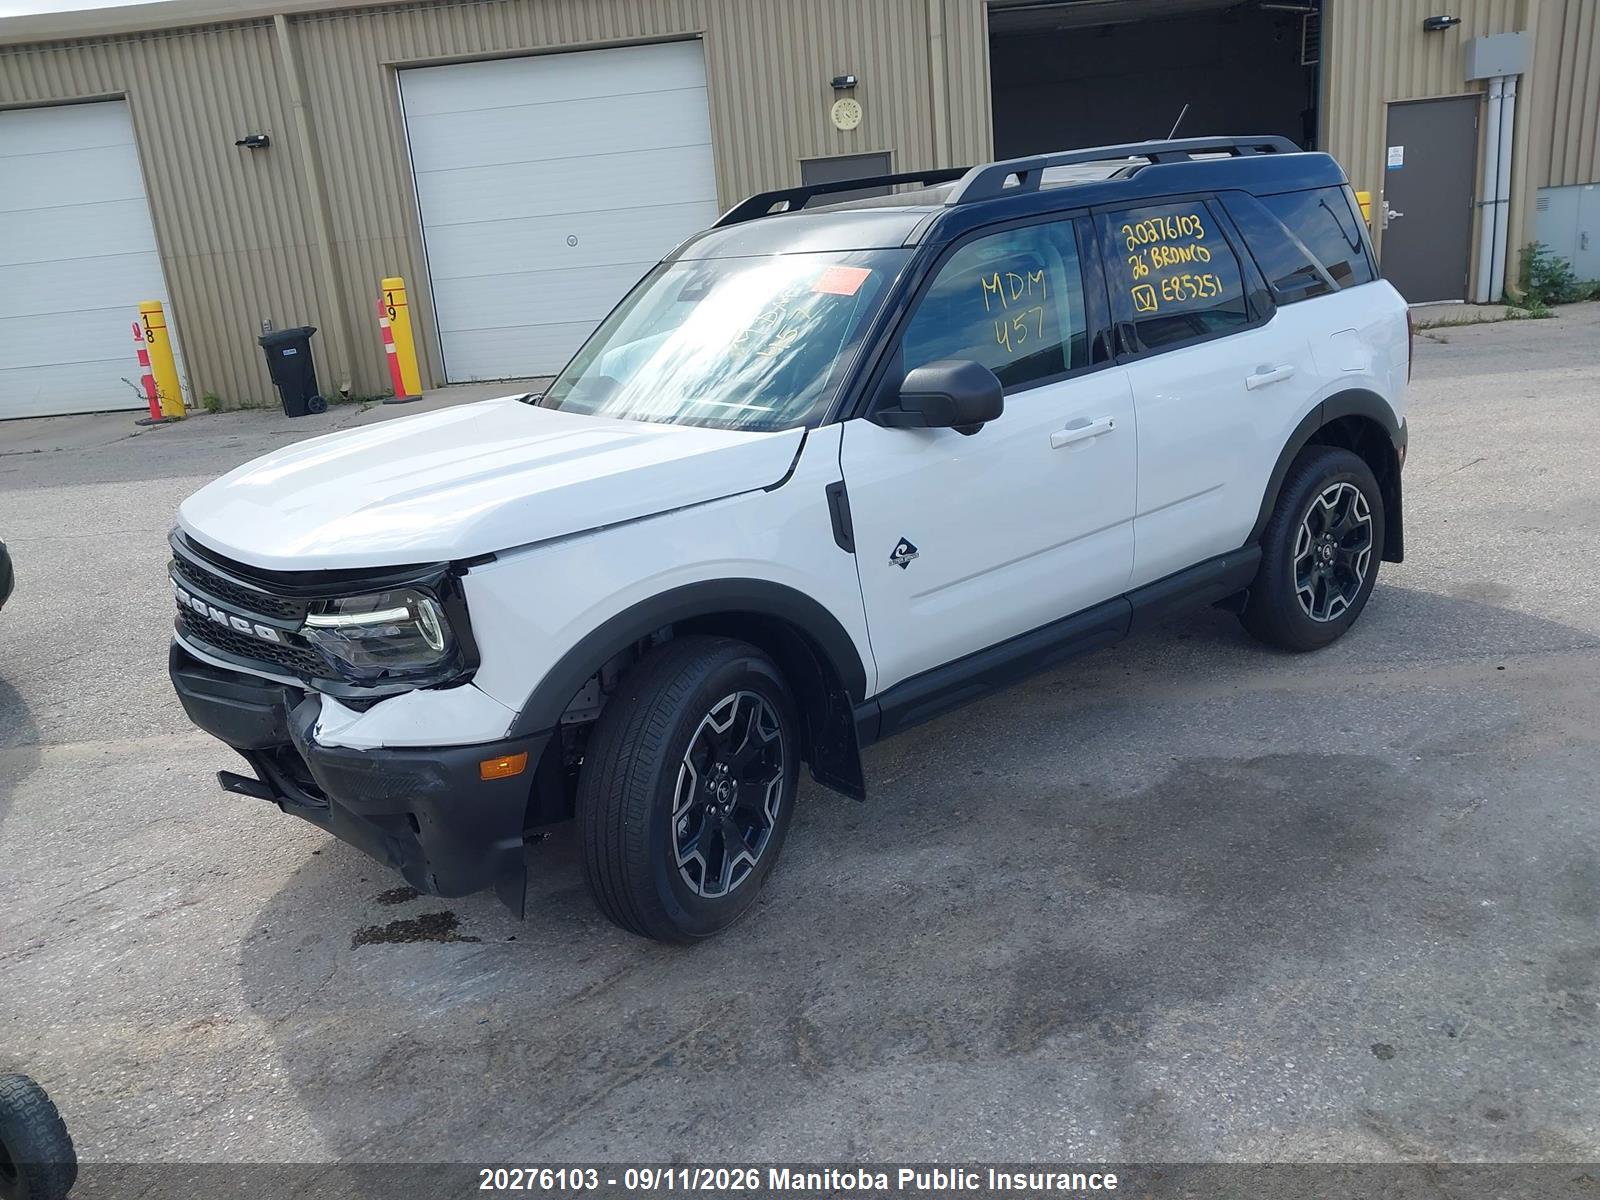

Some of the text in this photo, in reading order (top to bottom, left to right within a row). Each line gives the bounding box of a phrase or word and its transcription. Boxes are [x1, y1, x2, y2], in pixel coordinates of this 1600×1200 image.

[1122, 214, 1205, 252] 20276103
[1151, 243, 1211, 269] BRONCO
[981, 269, 1046, 312] MDM
[1161, 274, 1223, 301] E85251
[994, 306, 1043, 353] 457
